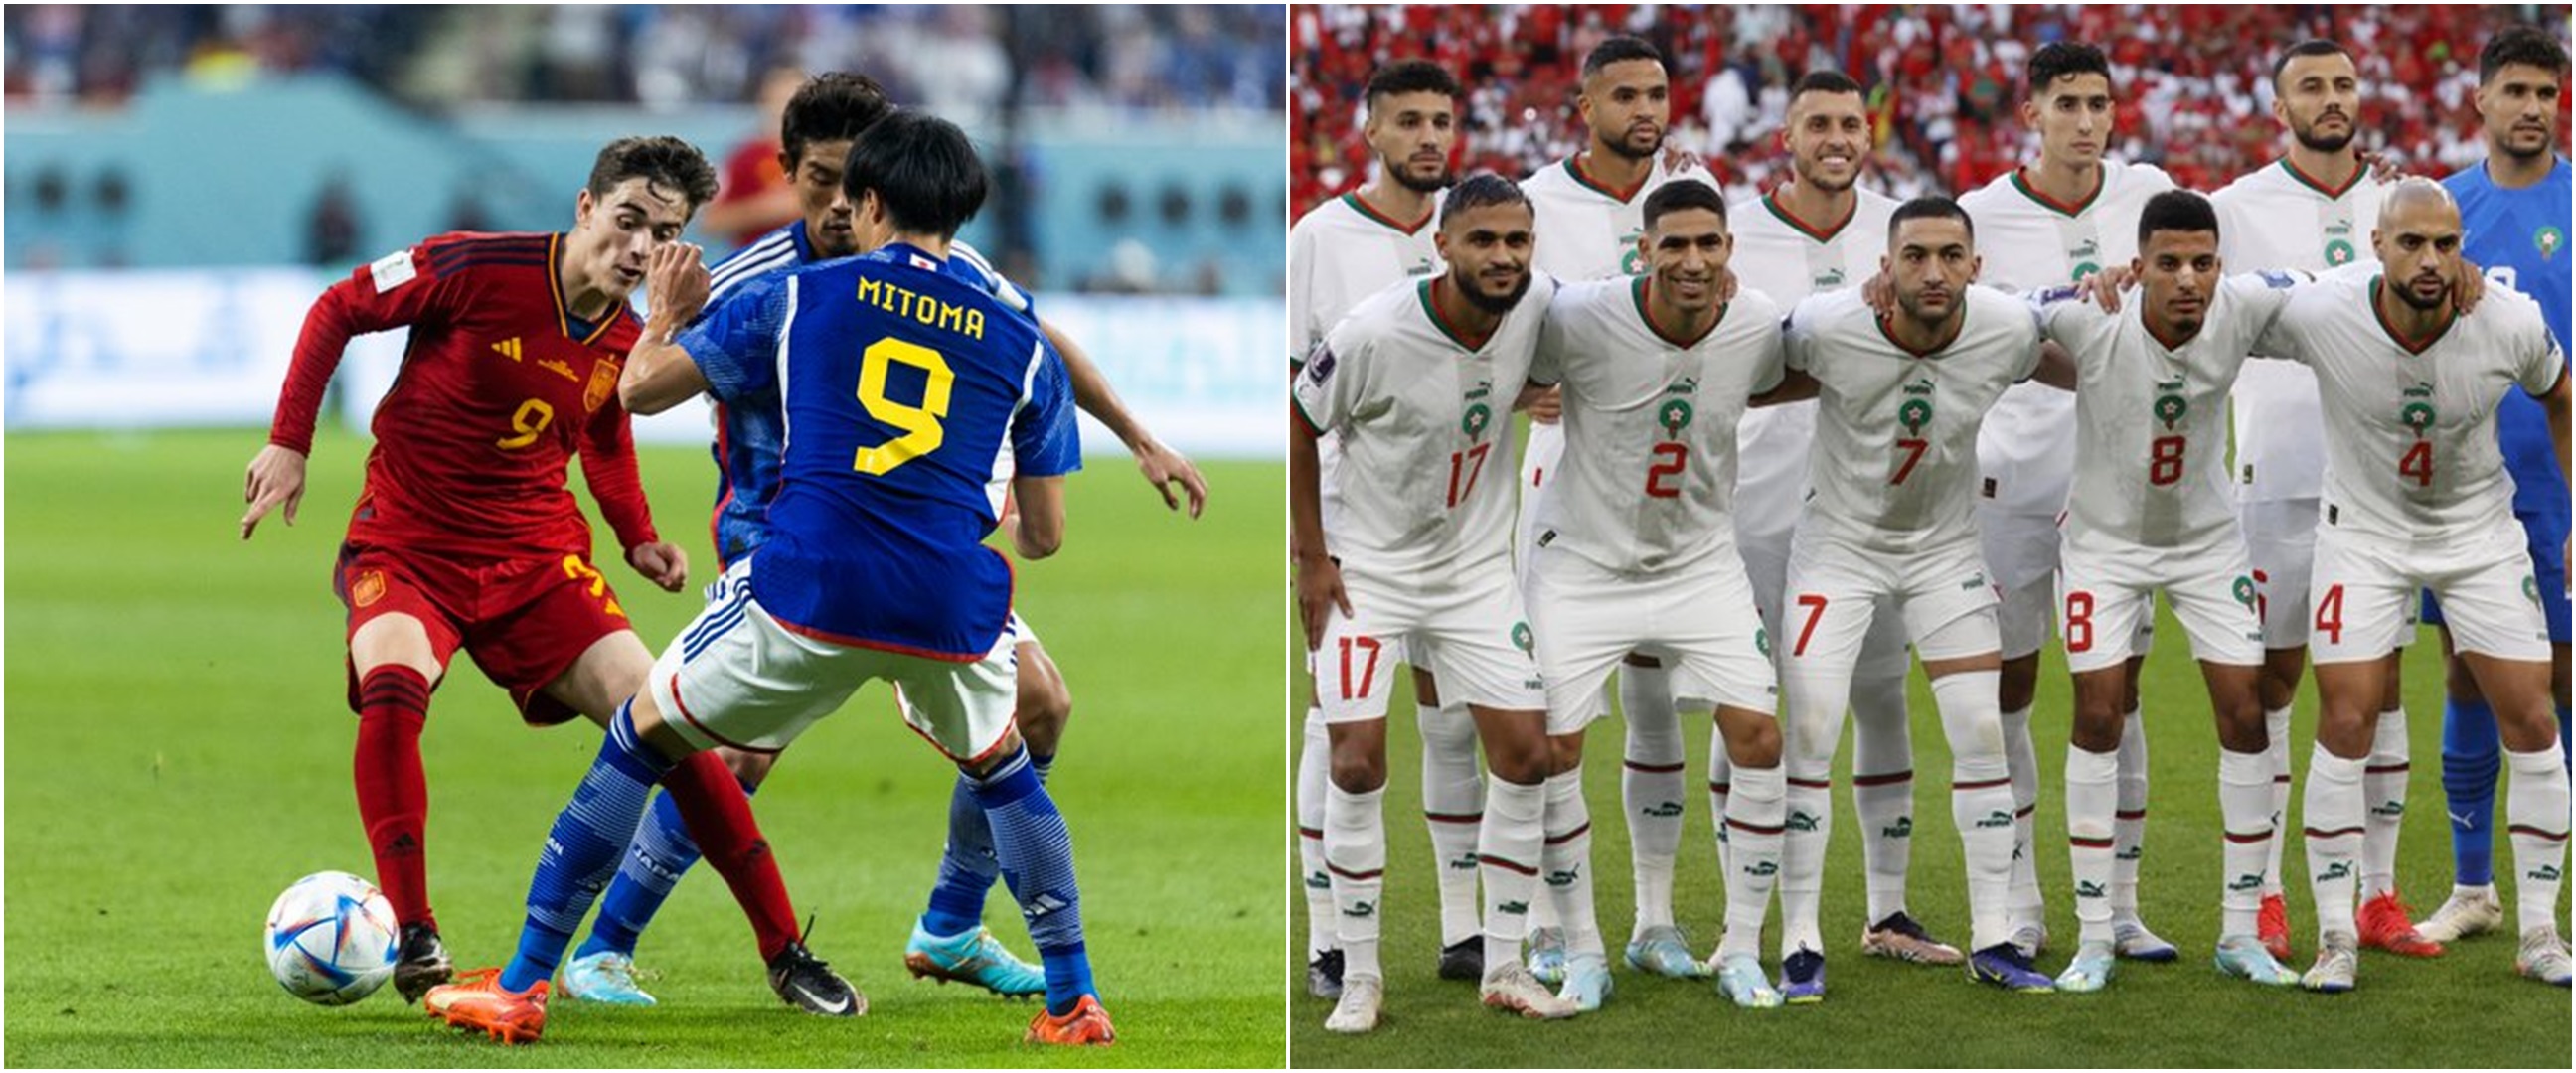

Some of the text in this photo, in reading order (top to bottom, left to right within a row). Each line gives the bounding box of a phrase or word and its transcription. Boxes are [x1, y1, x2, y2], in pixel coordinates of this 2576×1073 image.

[857, 275, 985, 341] MITOMA
[496, 398, 554, 450] 9
[853, 336, 956, 477] 9
[1447, 441, 1491, 509] 17
[1645, 442, 1688, 498] 2
[1889, 438, 1929, 486] 7
[2150, 434, 2186, 486] 8
[2399, 441, 2433, 487] 4
[1793, 594, 1828, 657] 7
[2066, 591, 2094, 654] 8
[2315, 583, 2344, 644] 4
[1339, 636, 1382, 700] 17
